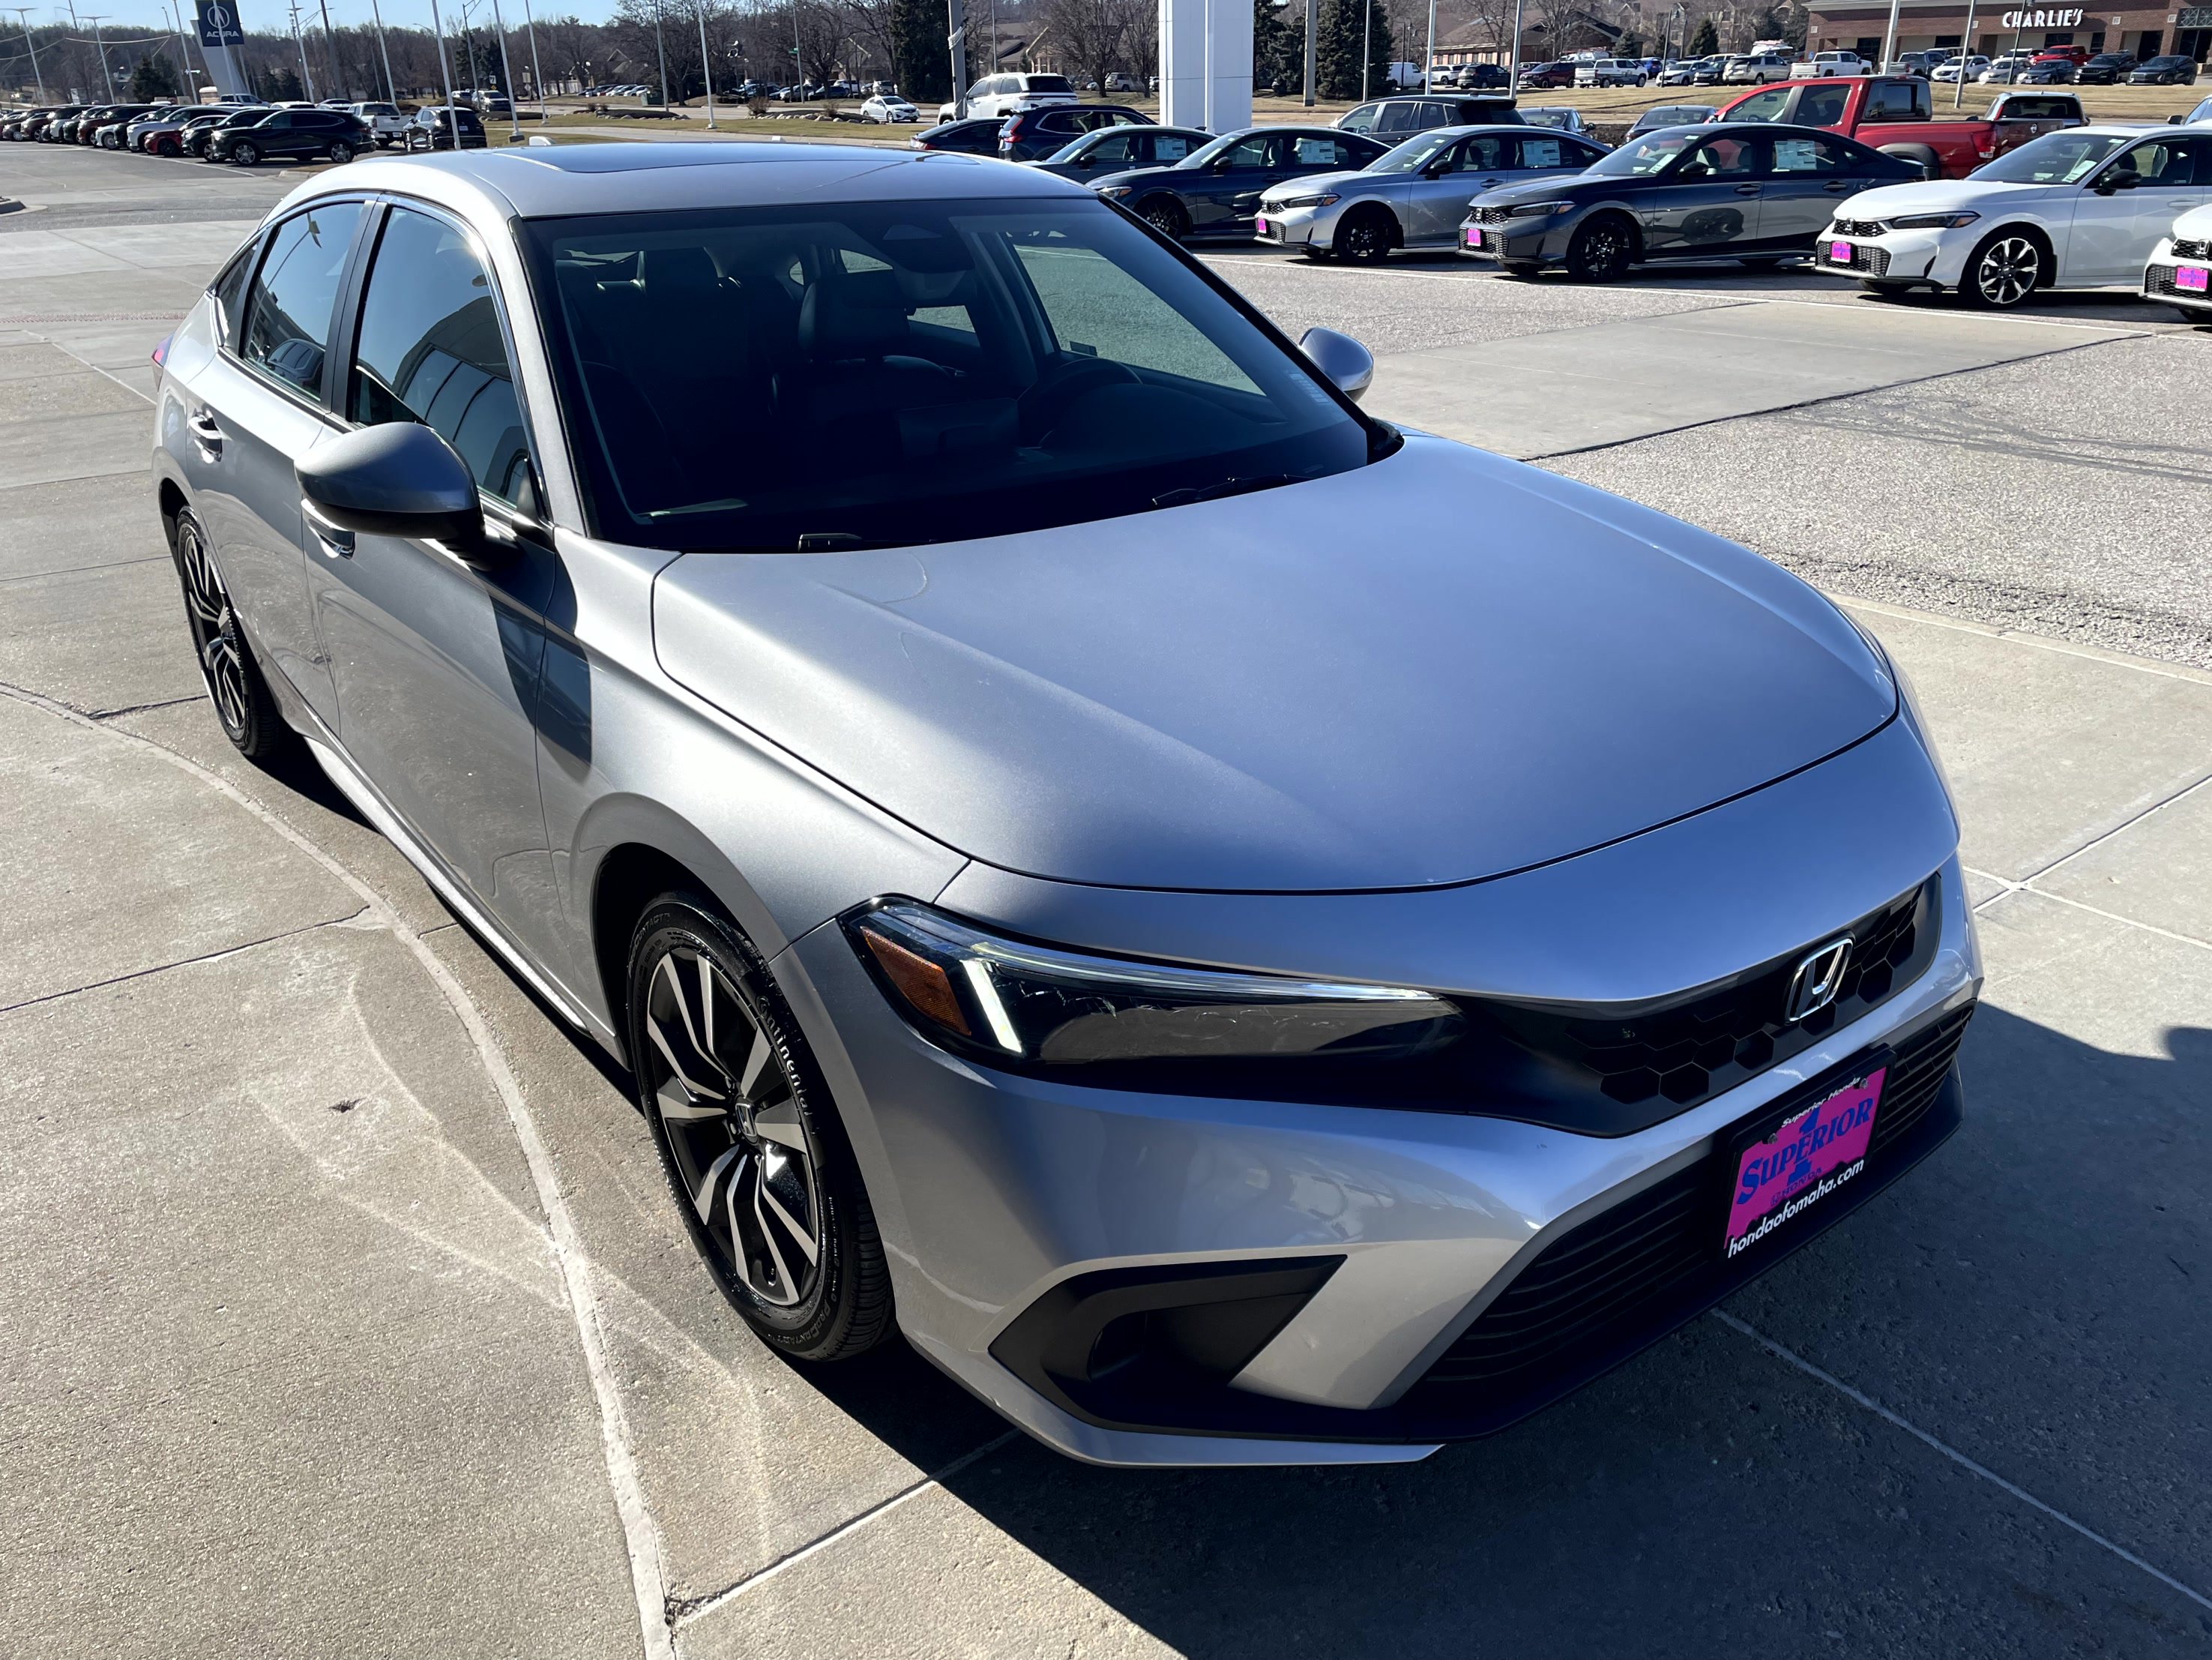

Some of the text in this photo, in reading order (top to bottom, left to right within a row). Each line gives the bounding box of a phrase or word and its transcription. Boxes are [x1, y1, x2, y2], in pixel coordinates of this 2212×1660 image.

[2002, 8, 2084, 28] CHARLIE'S
[1781, 1077, 1861, 1128] Superior Honda
[1736, 1098, 1874, 1205] SUPERIOR
[1728, 1158, 1864, 1258] hondaofomaha.com
